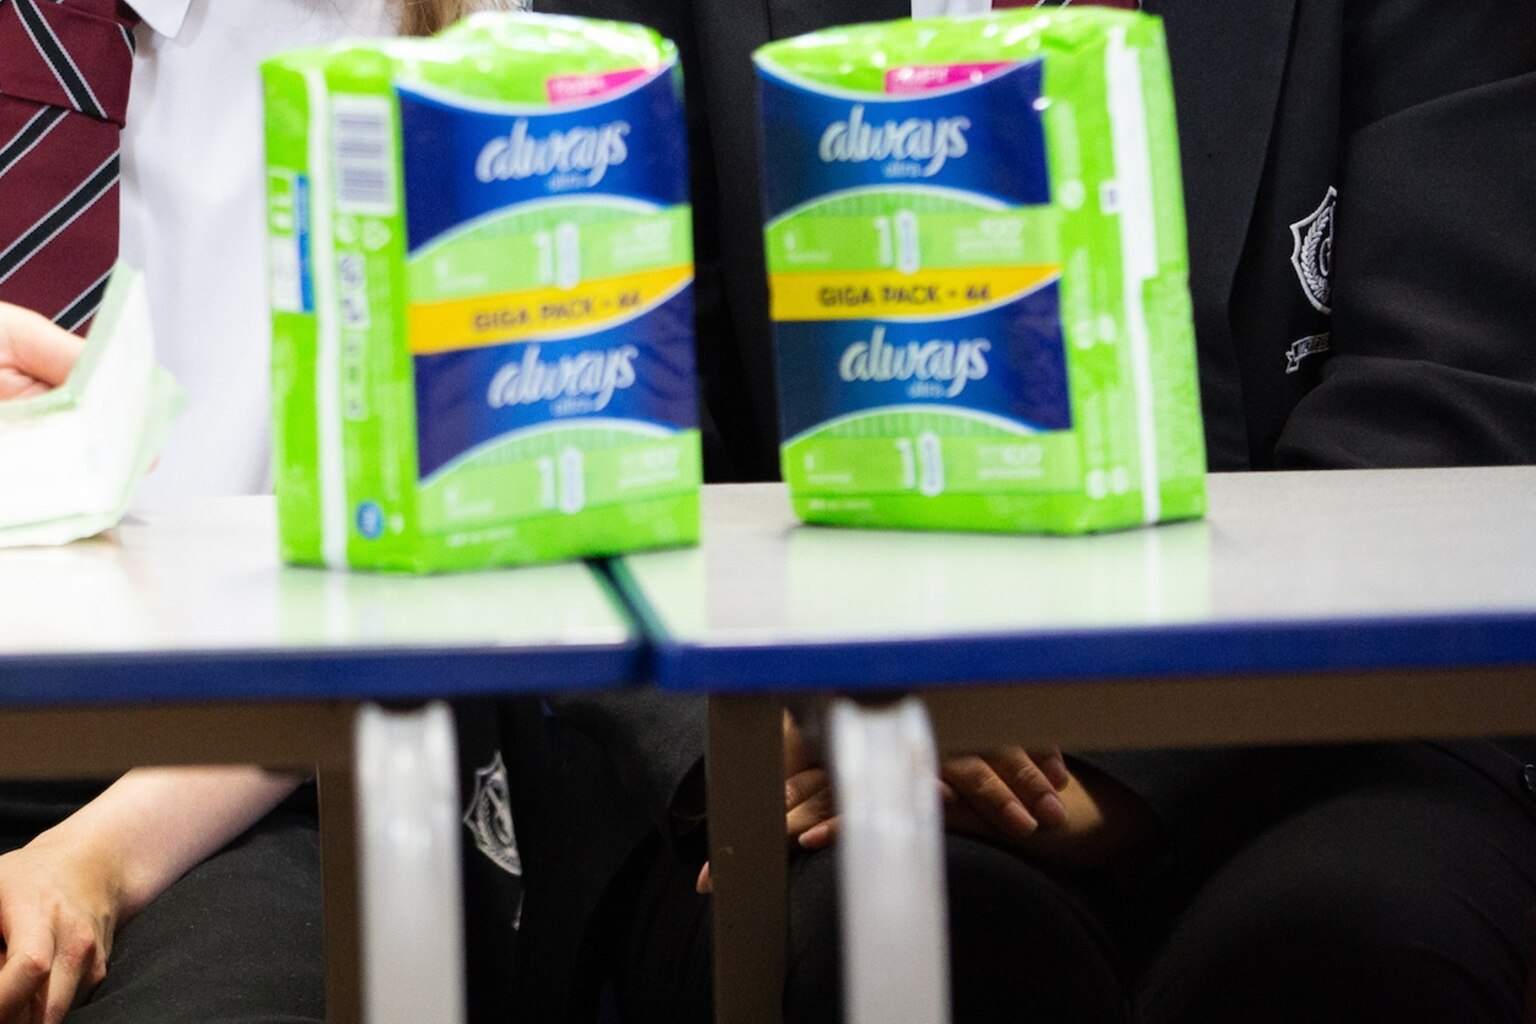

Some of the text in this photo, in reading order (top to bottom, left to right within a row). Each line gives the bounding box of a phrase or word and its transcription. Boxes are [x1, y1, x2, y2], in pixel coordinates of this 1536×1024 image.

[475, 118, 631, 188] always
[819, 103, 971, 177] always
[473, 308, 529, 333] GIGA
[541, 299, 594, 321] PACK
[820, 286, 874, 307] GIGA
[882, 285, 939, 306] PACK
[487, 343, 638, 412] always
[839, 326, 991, 397] always
